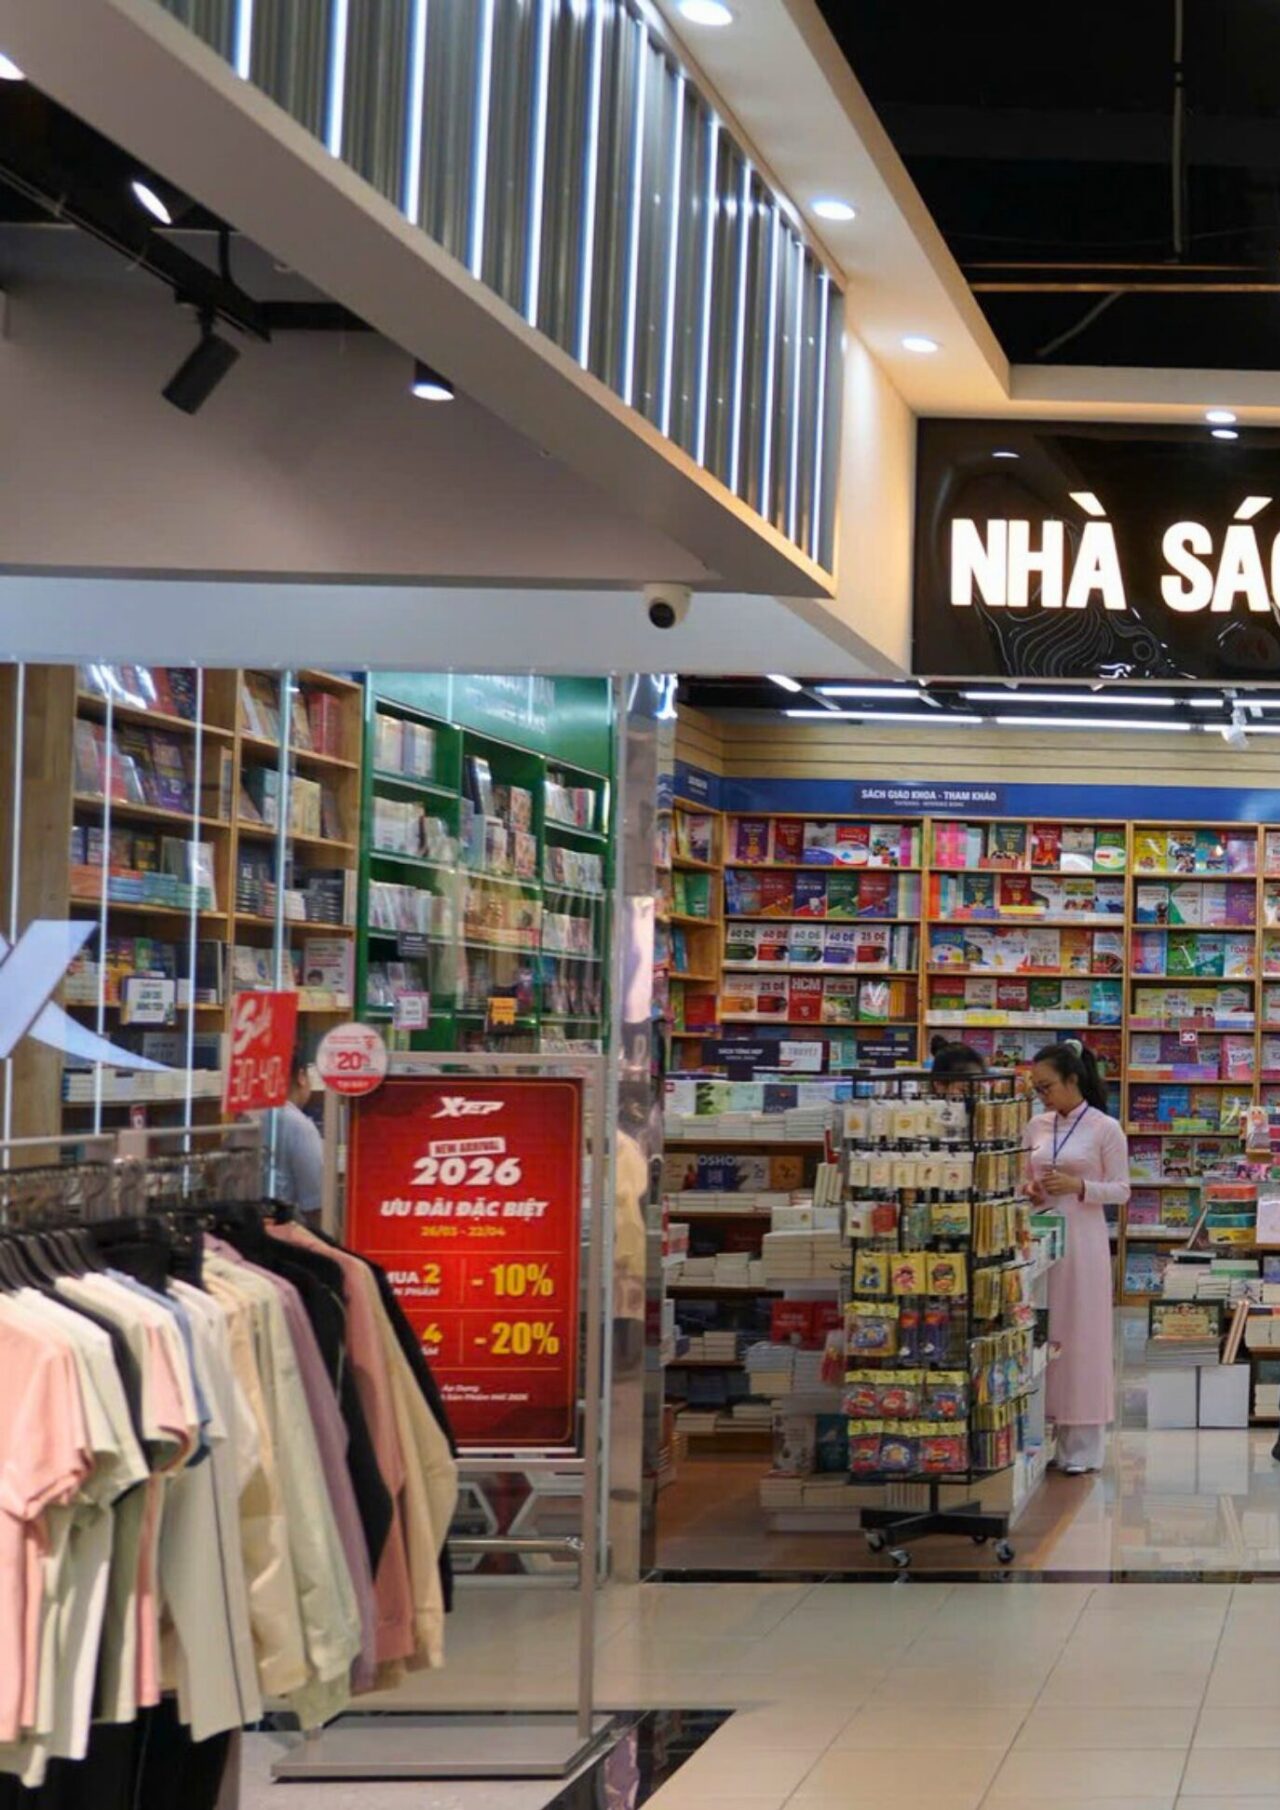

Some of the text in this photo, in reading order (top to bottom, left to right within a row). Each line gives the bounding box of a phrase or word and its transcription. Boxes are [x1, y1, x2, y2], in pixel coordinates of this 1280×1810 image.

[951, 491, 1127, 612] NHÀ
[861, 787, 886, 799] SÁCH
[888, 788, 910, 799] GIÁO
[911, 790, 936, 800] KHOA
[943, 790, 970, 801] THAM
[409, 1156, 522, 1186] 2026
[380, 1197, 550, 1222] ƯU ĐÃI ĐẶC BIỆT
[422, 1263, 441, 1285] 2
[490, 1262, 554, 1297] 10%
[422, 1322, 443, 1344] 4
[491, 1321, 560, 1355] 20%
